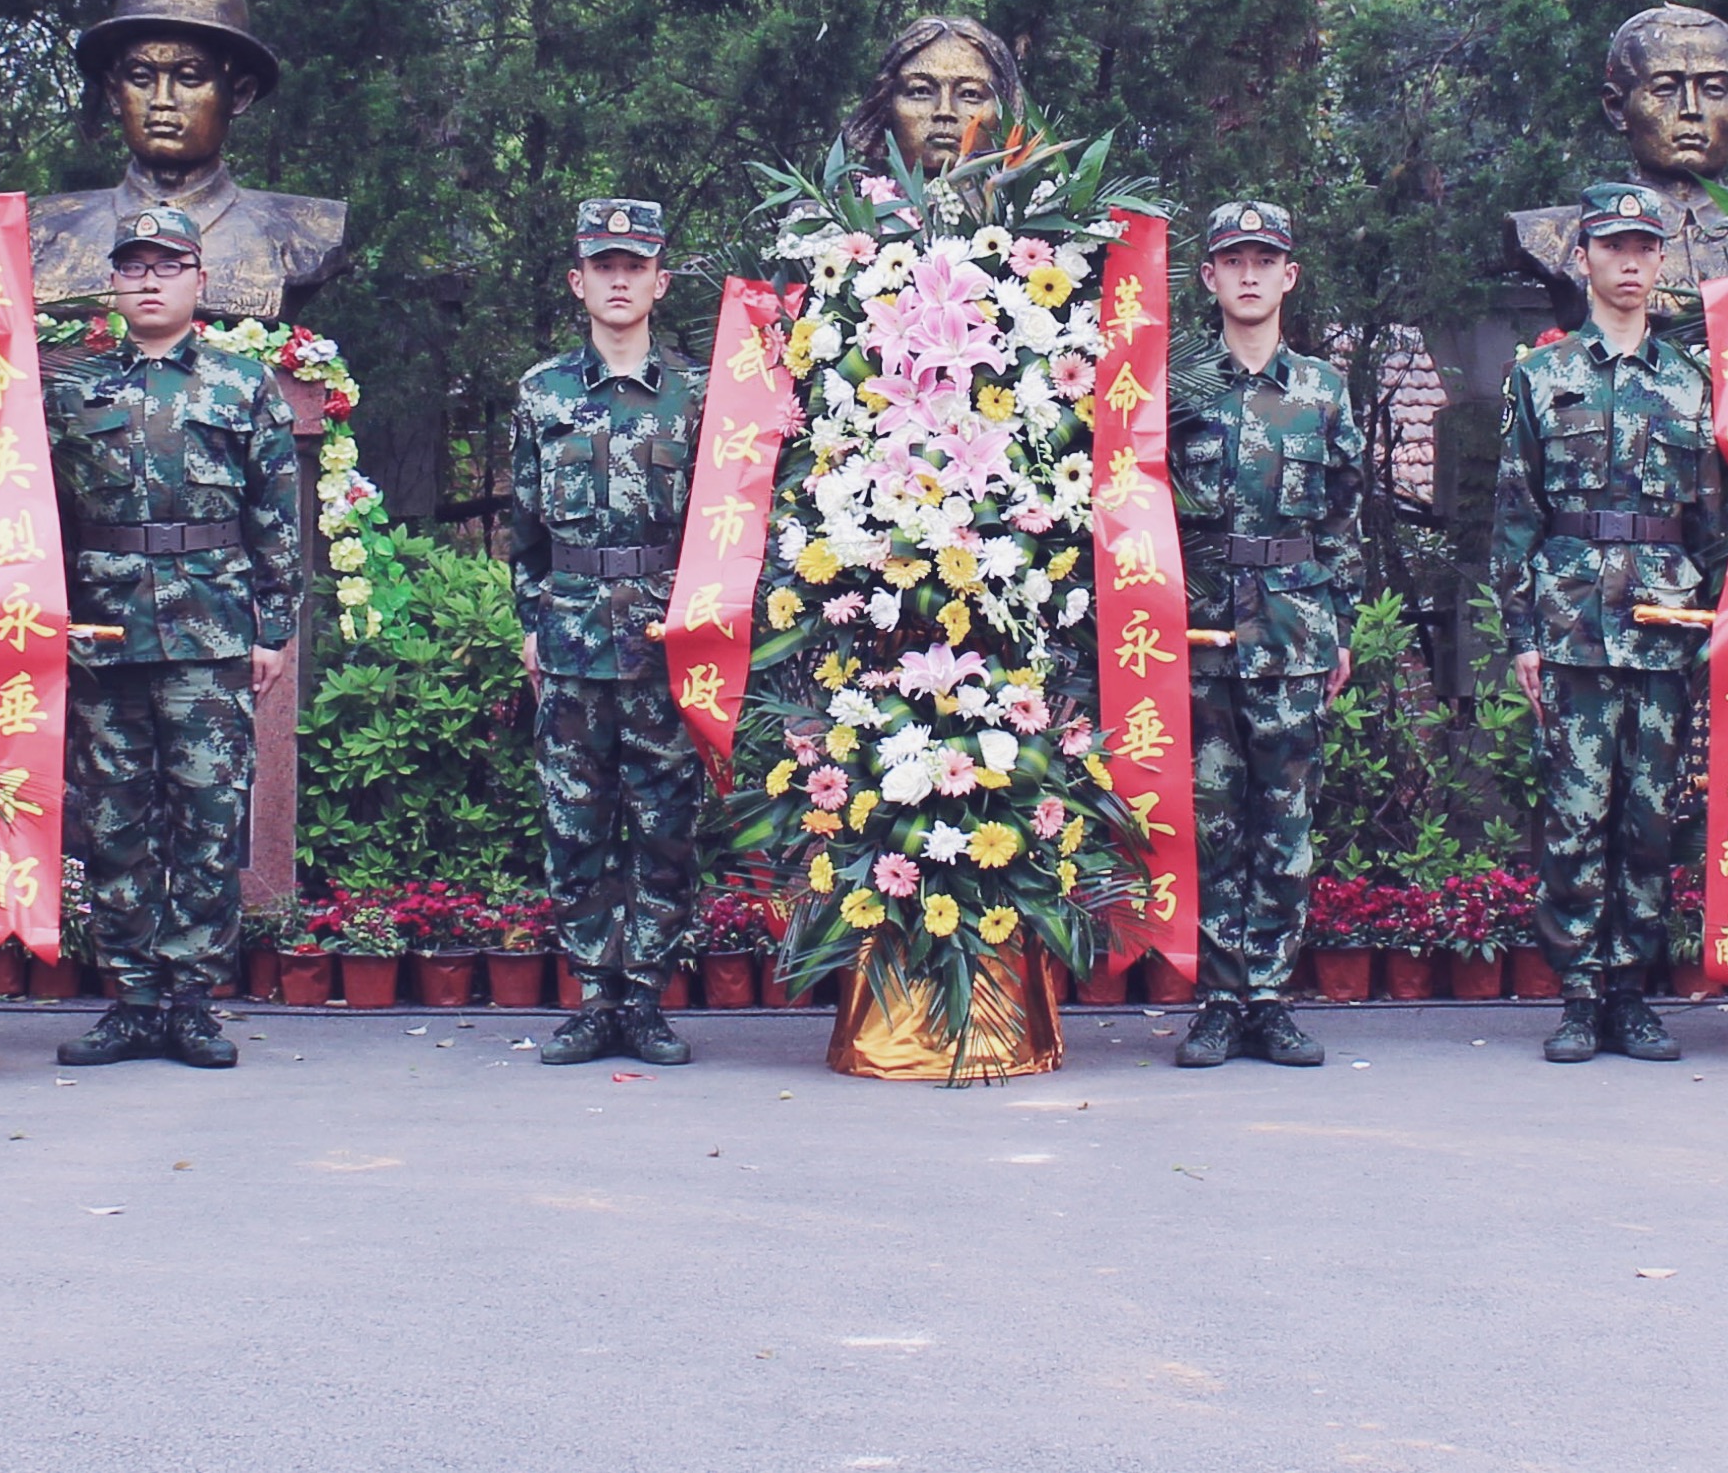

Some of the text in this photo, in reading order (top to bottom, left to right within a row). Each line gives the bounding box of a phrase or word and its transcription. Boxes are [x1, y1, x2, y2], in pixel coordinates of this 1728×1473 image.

[1100, 277, 1177, 923] 革命英烈永垂不朽
